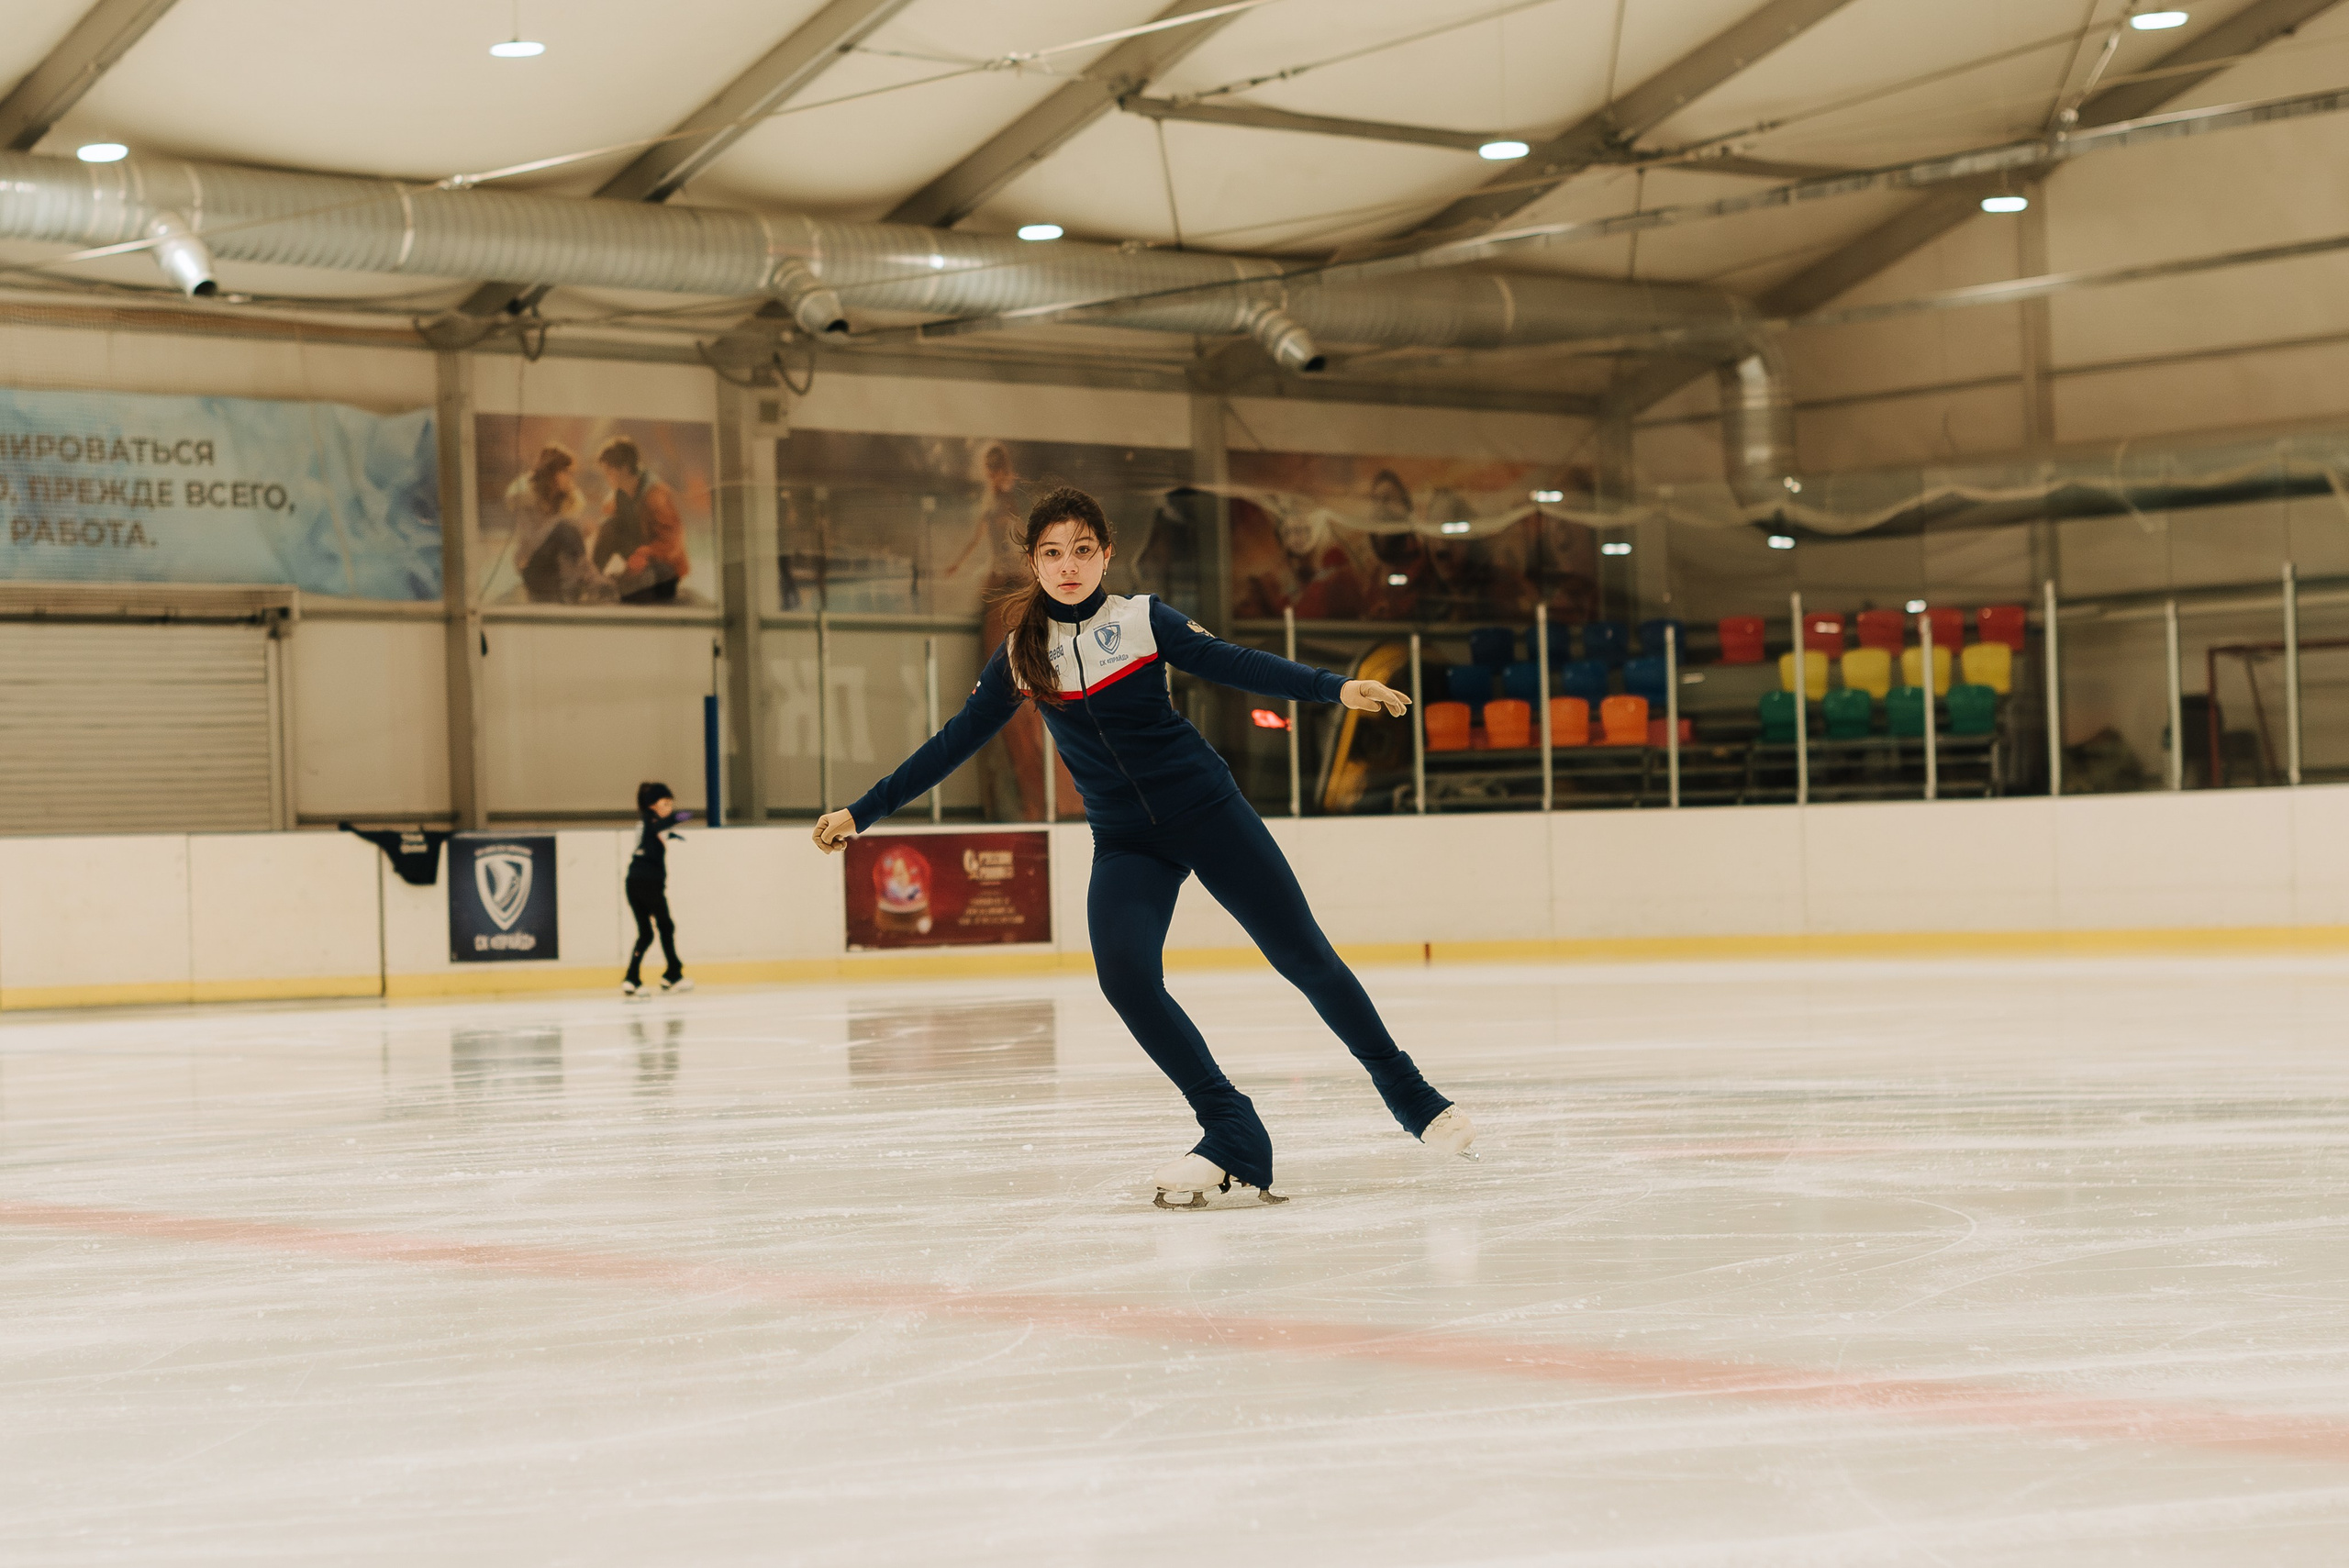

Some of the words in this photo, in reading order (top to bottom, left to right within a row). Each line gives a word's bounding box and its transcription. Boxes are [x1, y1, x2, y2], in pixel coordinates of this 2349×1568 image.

[28, 475, 174, 509] ПРЕЖДЕ
[186, 480, 296, 514] ВСЕГО,
[11, 516, 158, 549] РАБОТА.
